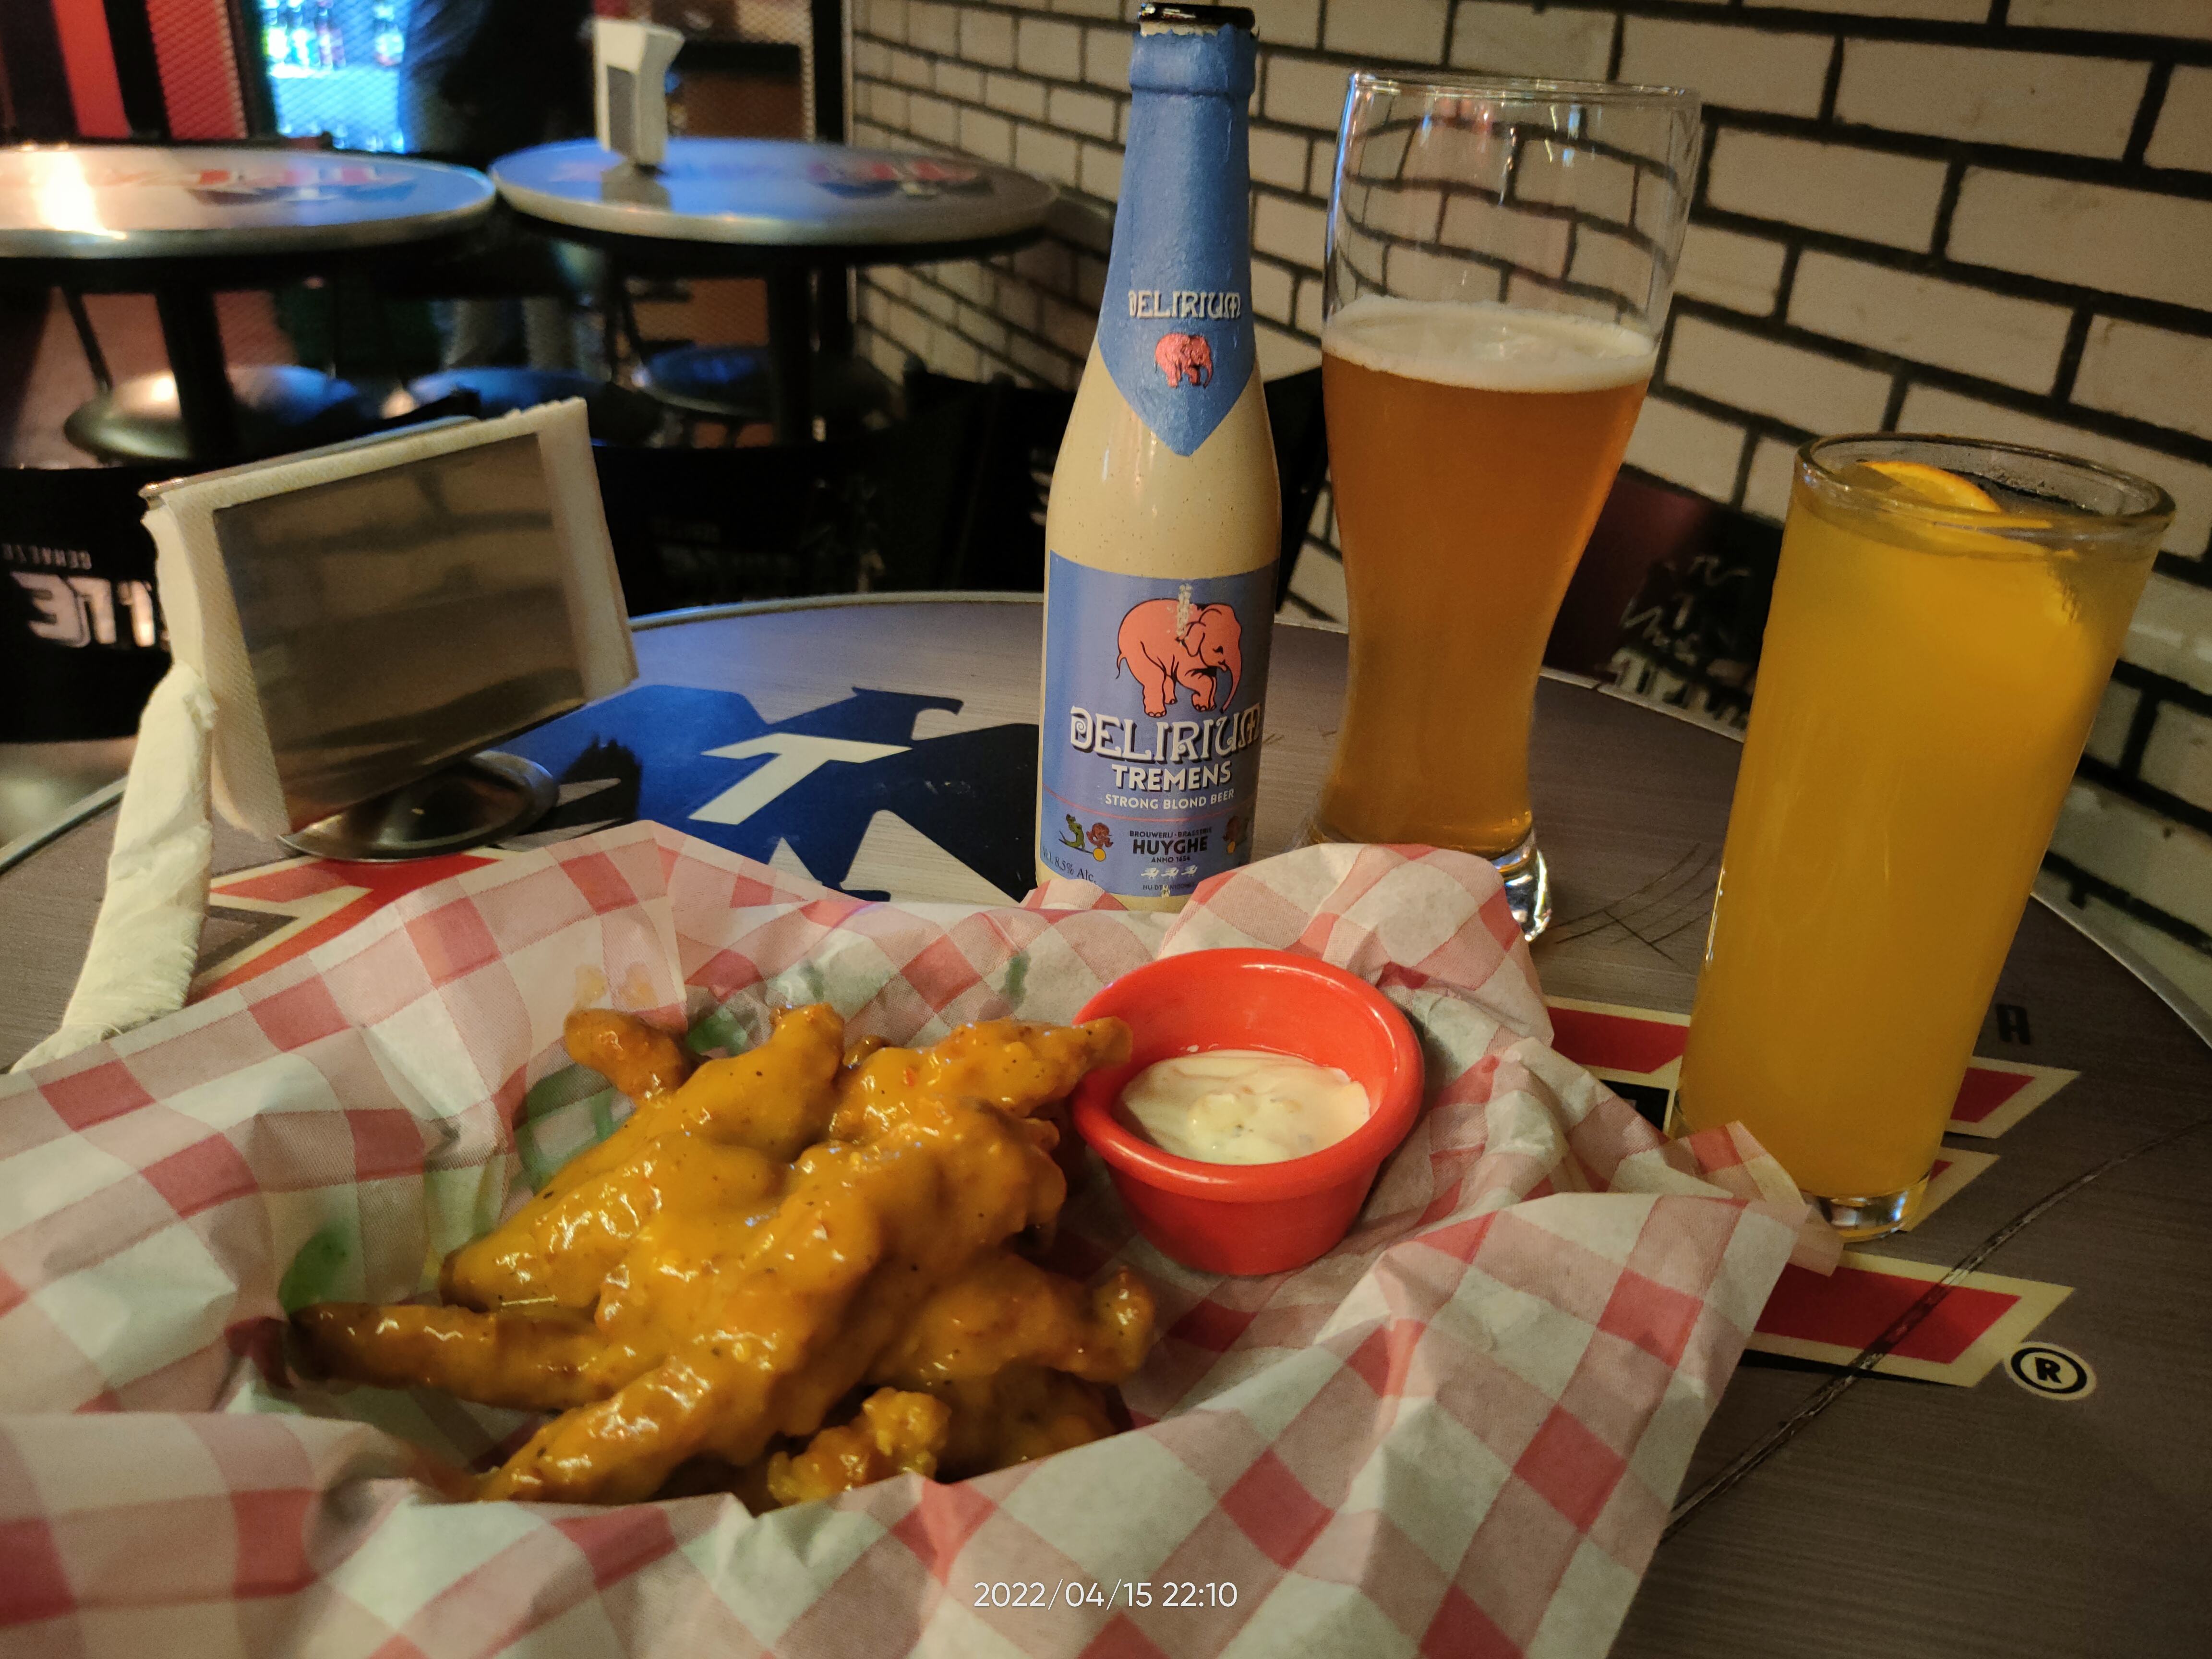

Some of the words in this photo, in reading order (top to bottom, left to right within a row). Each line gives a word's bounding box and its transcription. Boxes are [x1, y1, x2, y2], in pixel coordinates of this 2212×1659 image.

[1128, 290, 1241, 319] DELIRIUM
[1070, 703, 1261, 763] DELIRIUM
[1111, 760, 1232, 792] TREMENS
[1105, 794, 1158, 809] STRONG
[1163, 796, 1206, 810] BLOND
[1210, 788, 1234, 805] BEER
[1130, 830, 1173, 839] BROUWERIJ
[1133, 835, 1208, 855] HUYGHE
[1076, 868, 1095, 883] Alc.
